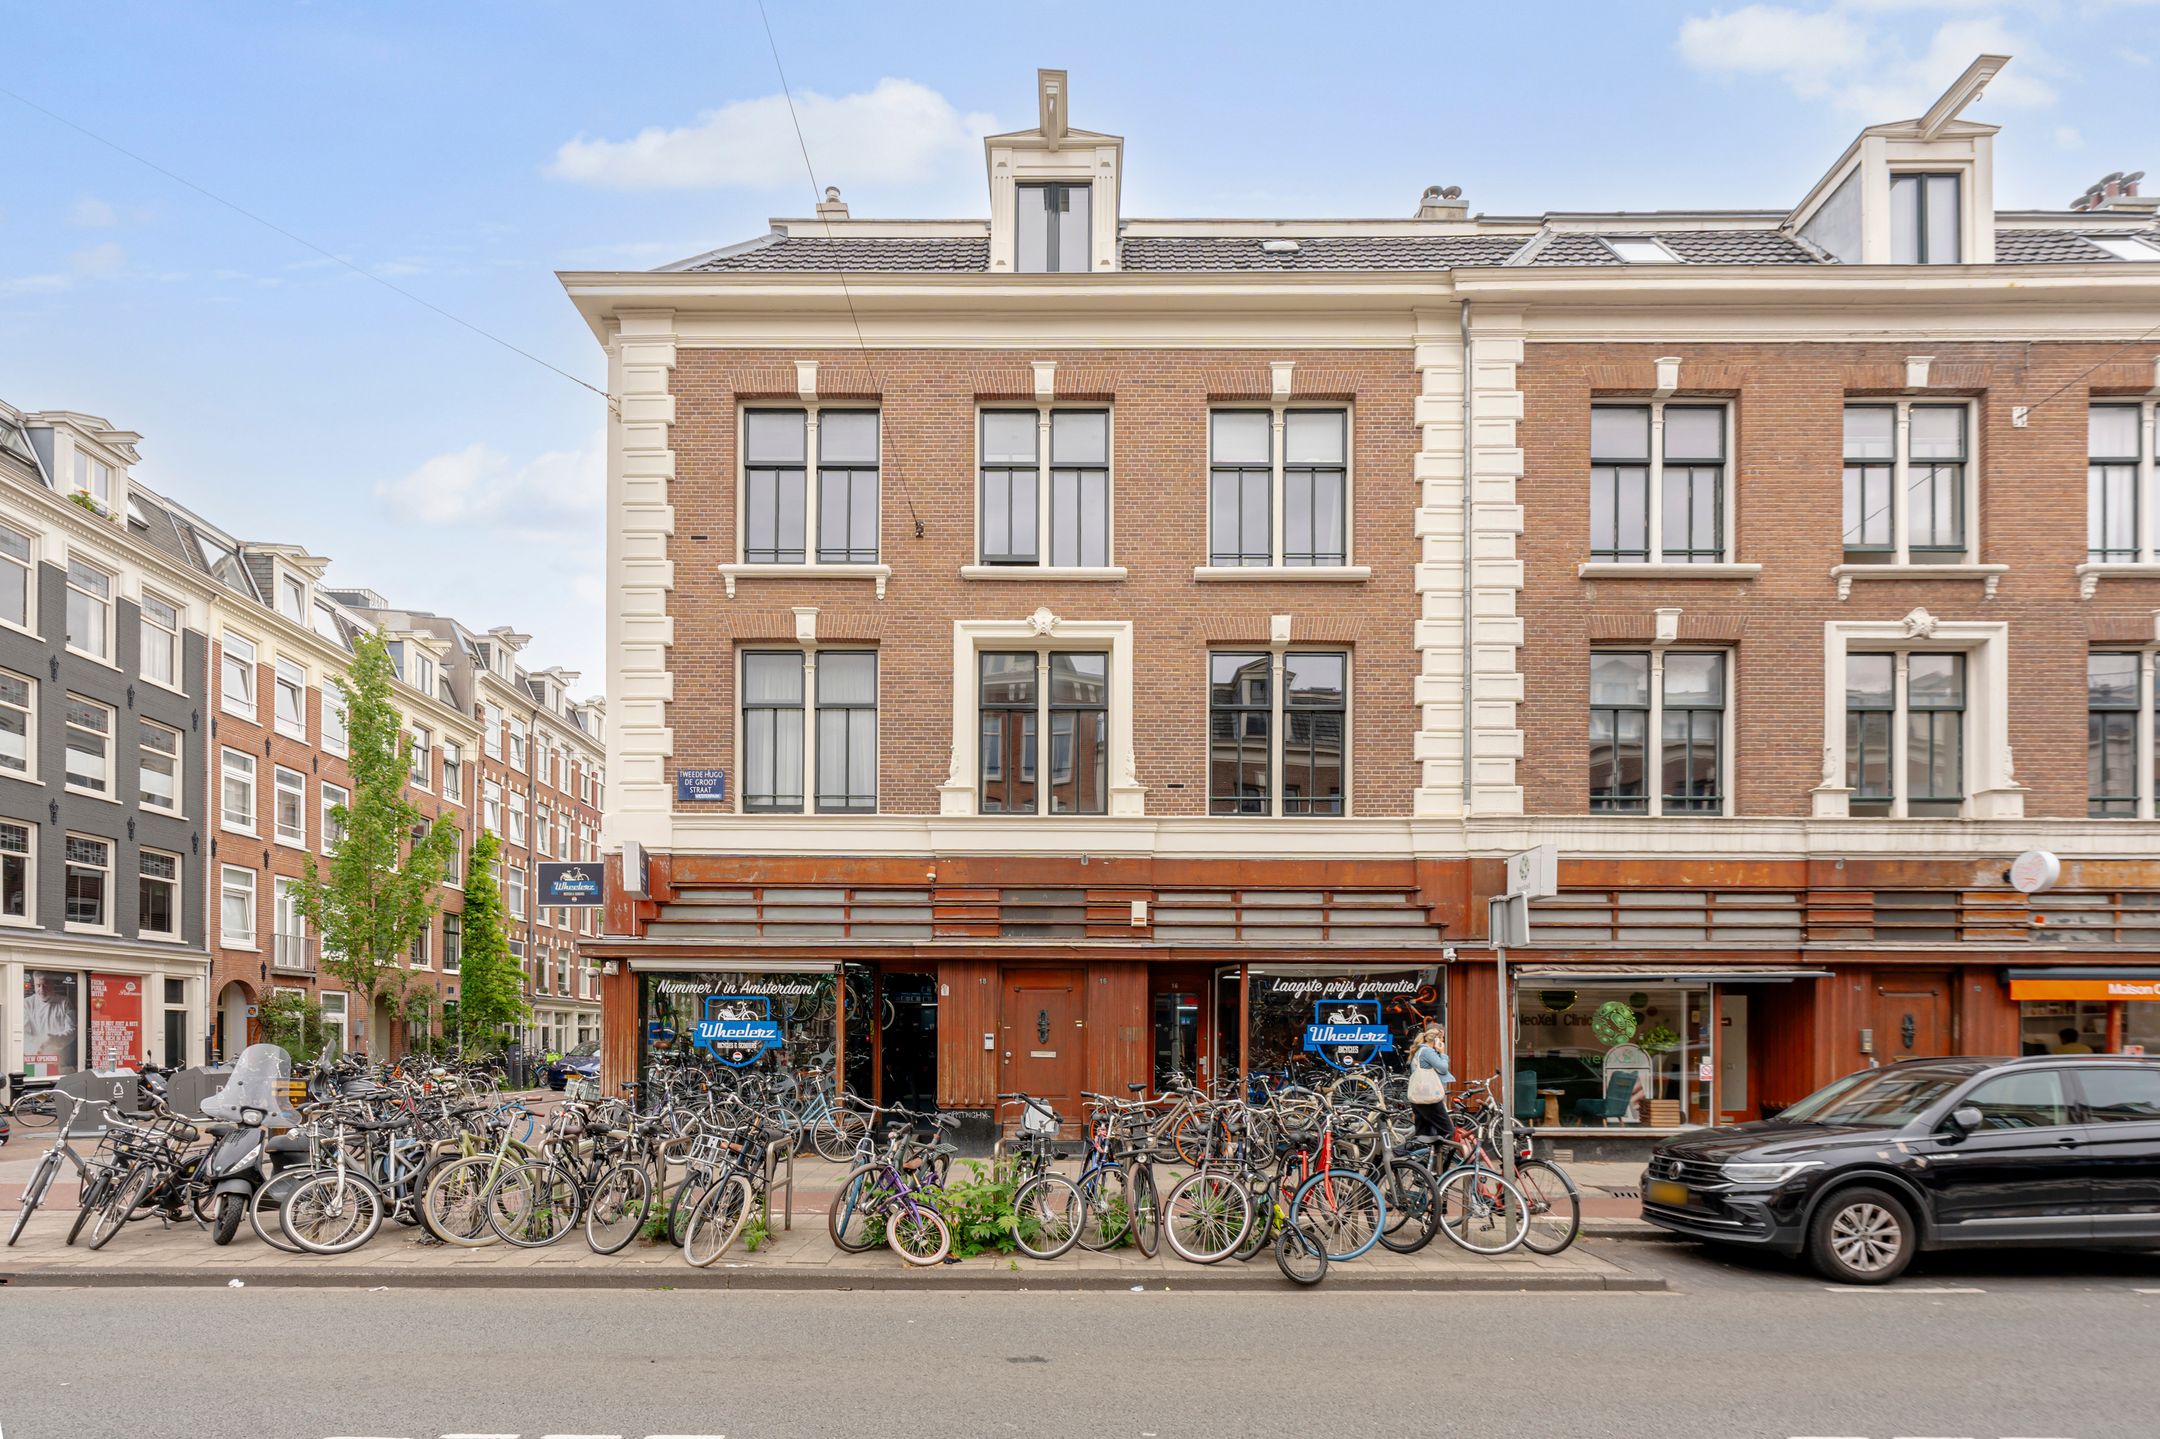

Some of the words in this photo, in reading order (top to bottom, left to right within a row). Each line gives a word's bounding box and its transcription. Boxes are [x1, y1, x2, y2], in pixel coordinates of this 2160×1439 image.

[680, 770, 703, 778] TWEEDE
[704, 770, 724, 778] HUGO
[690, 786, 712, 794] STRAAT
[657, 979, 712, 994] Nummer
[713, 981, 721, 994] 1
[723, 981, 737, 994] in
[740, 980, 820, 995] Amsterdam!
[1273, 978, 1323, 999] Laagste
[1322, 980, 1356, 999] prijs
[1357, 979, 1422, 999] garantie!
[2108, 983, 2153, 994] Maison
[700, 1022, 776, 1038] Wheelerz
[1310, 1026, 1387, 1042] Wheelerz
